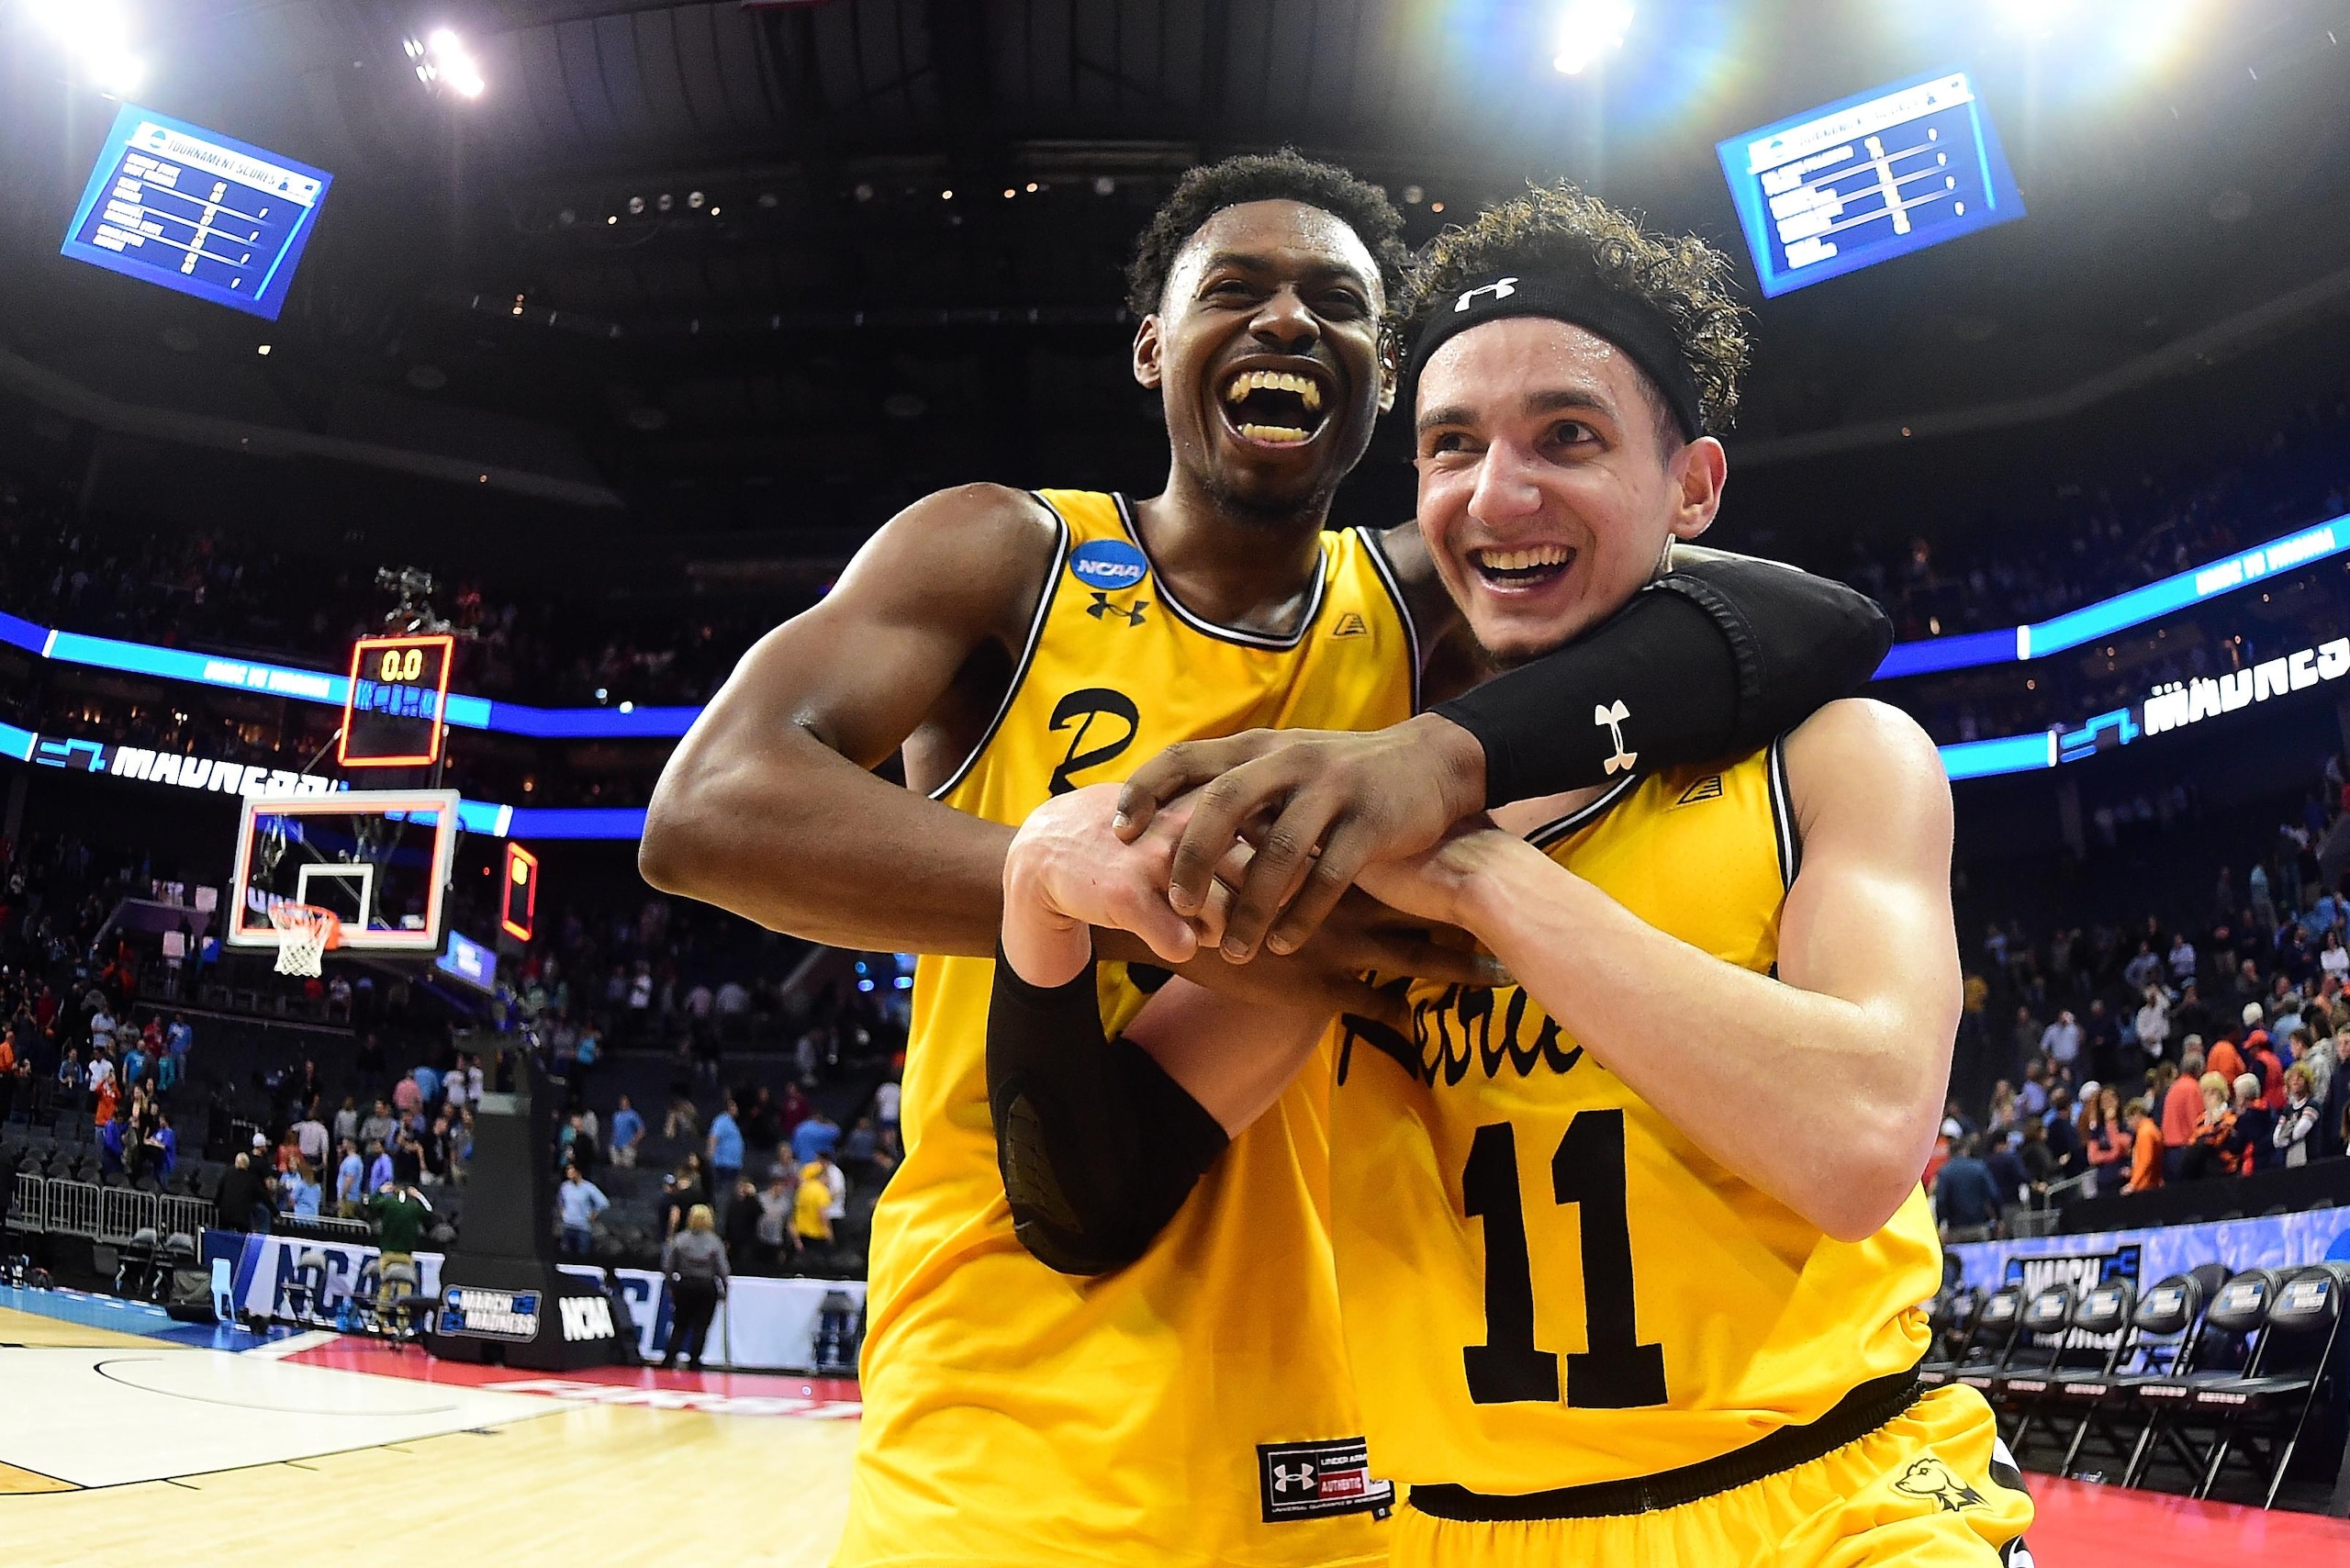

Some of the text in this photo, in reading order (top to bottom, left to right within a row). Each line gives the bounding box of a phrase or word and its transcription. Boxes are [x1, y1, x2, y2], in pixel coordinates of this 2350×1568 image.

[1078, 559, 1140, 578] NCAA
[380, 648, 423, 682] 0.0
[1462, 1108, 1669, 1409] 11
[461, 1290, 514, 1314] MARCH
[464, 1311, 538, 1336] MADNESS
[559, 1296, 616, 1341] NCAA
[1320, 1456, 1348, 1466] UNDER
[1322, 1477, 1361, 1492] AUTHENTIC
